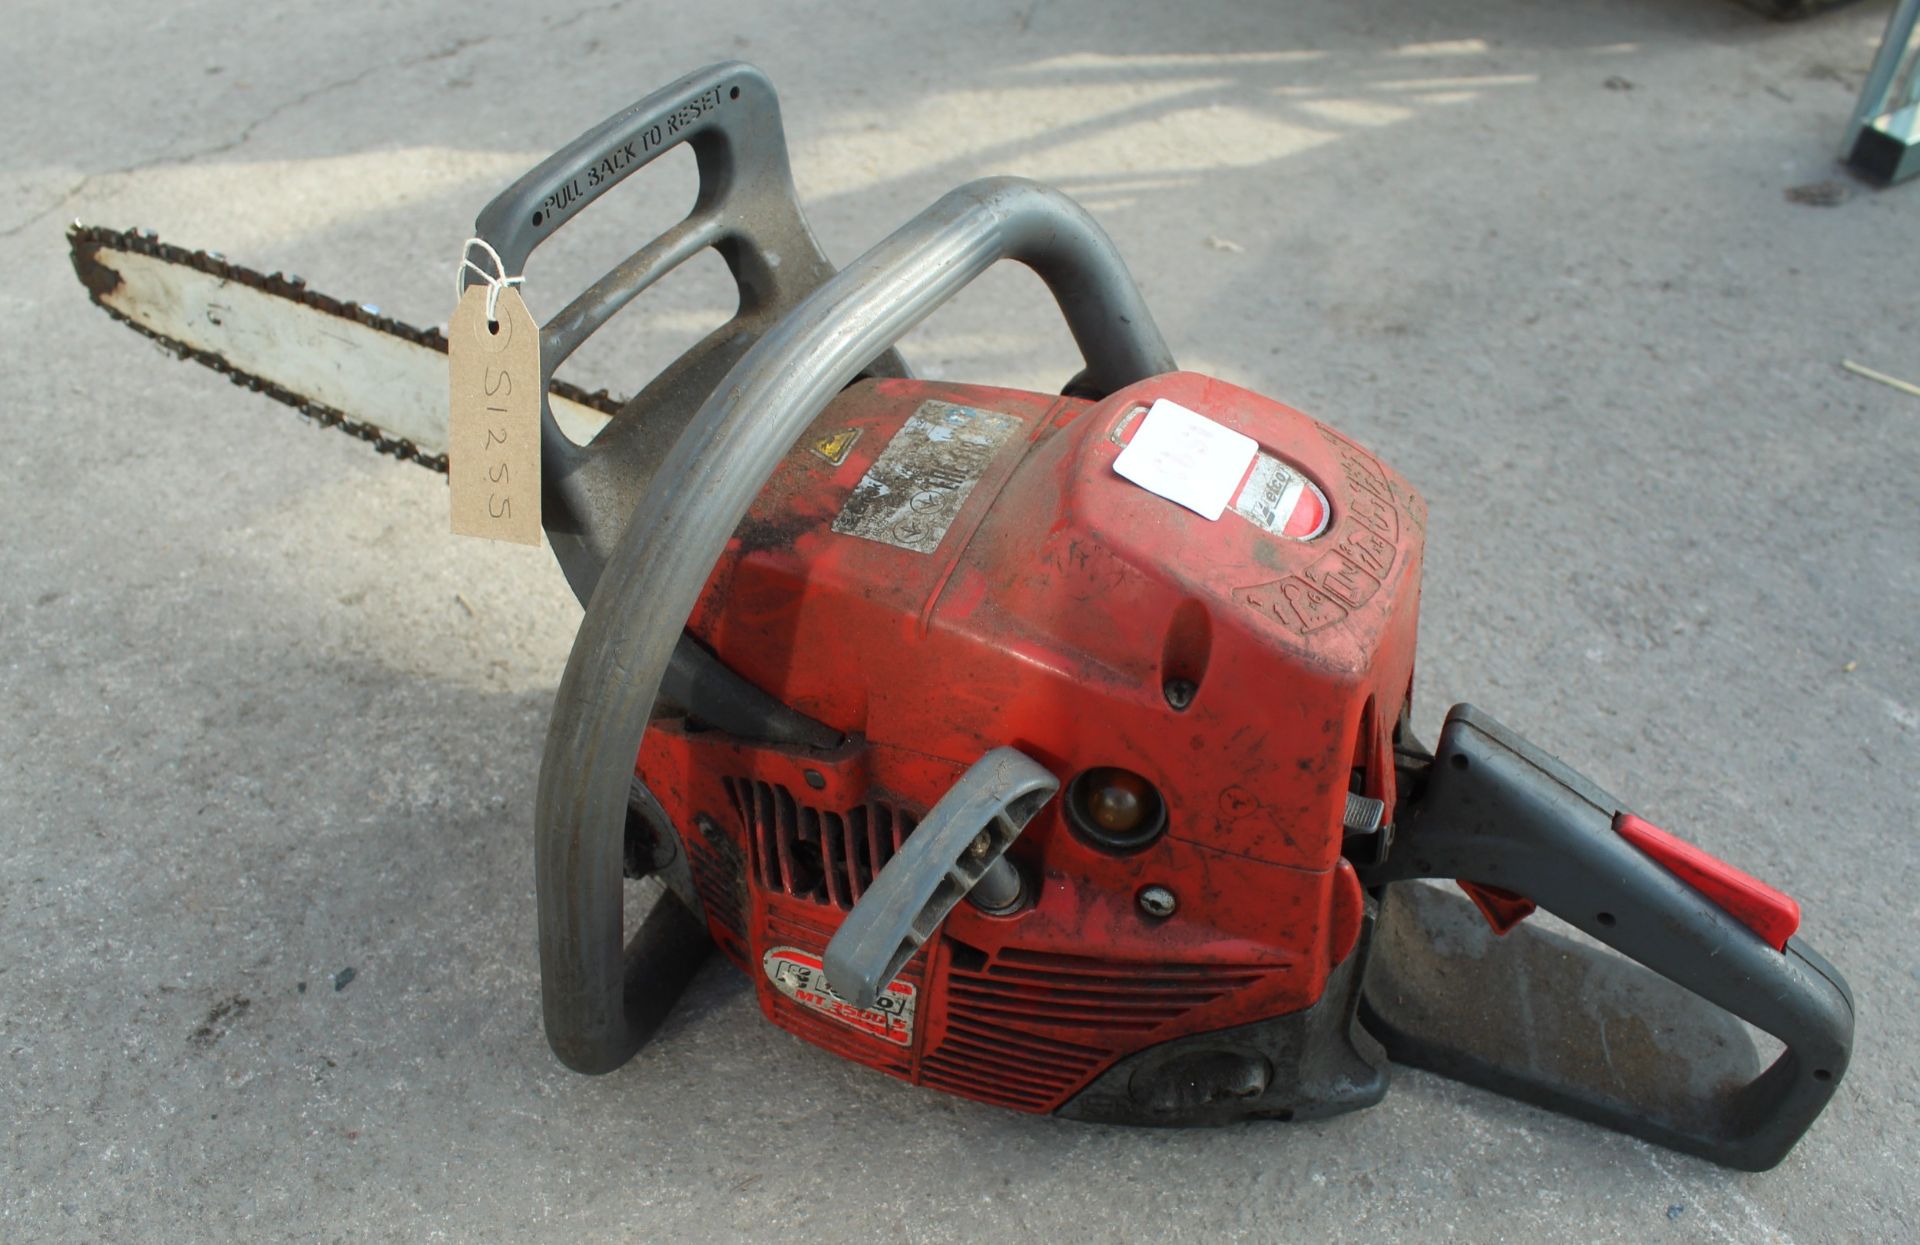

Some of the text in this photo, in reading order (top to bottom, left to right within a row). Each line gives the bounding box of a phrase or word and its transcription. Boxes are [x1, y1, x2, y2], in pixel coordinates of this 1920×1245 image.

[543, 85, 722, 219] PULL BACK TO RESET
[484, 367, 512, 519] S1255
[795, 989, 826, 1007] MT
